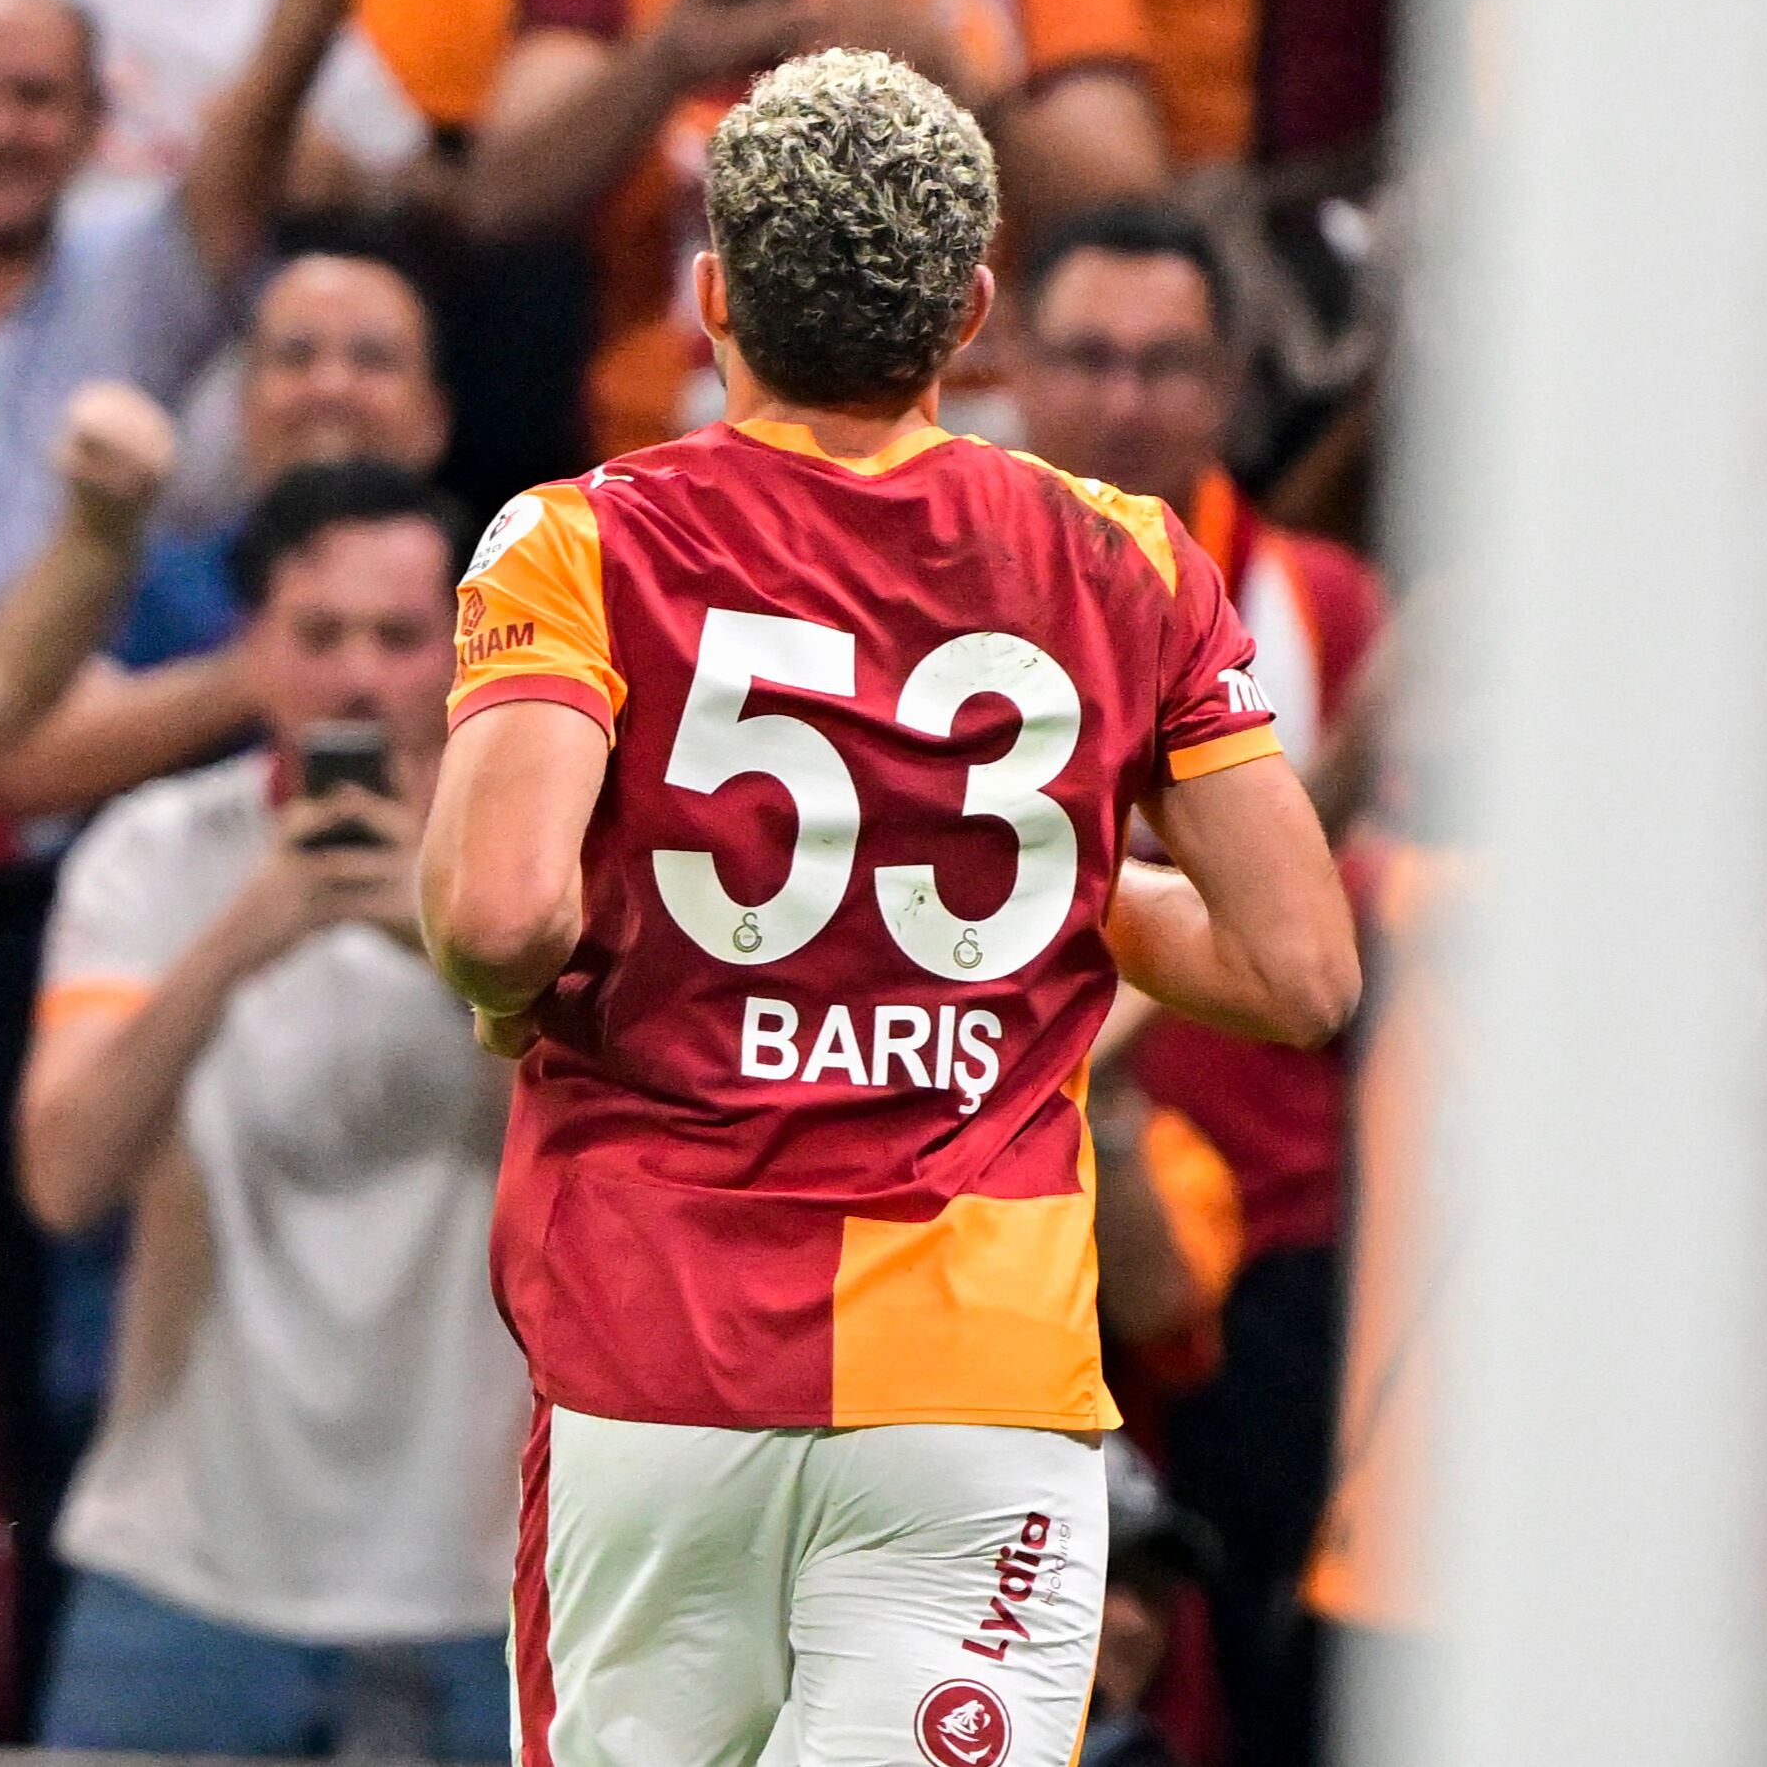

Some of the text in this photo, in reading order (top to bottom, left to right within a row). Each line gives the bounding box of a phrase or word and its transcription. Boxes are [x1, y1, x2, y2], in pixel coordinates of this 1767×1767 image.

[652, 607, 1081, 982] 53
[741, 996, 1002, 1115] BARIŞ
[962, 1511, 1051, 1661] Lydia
